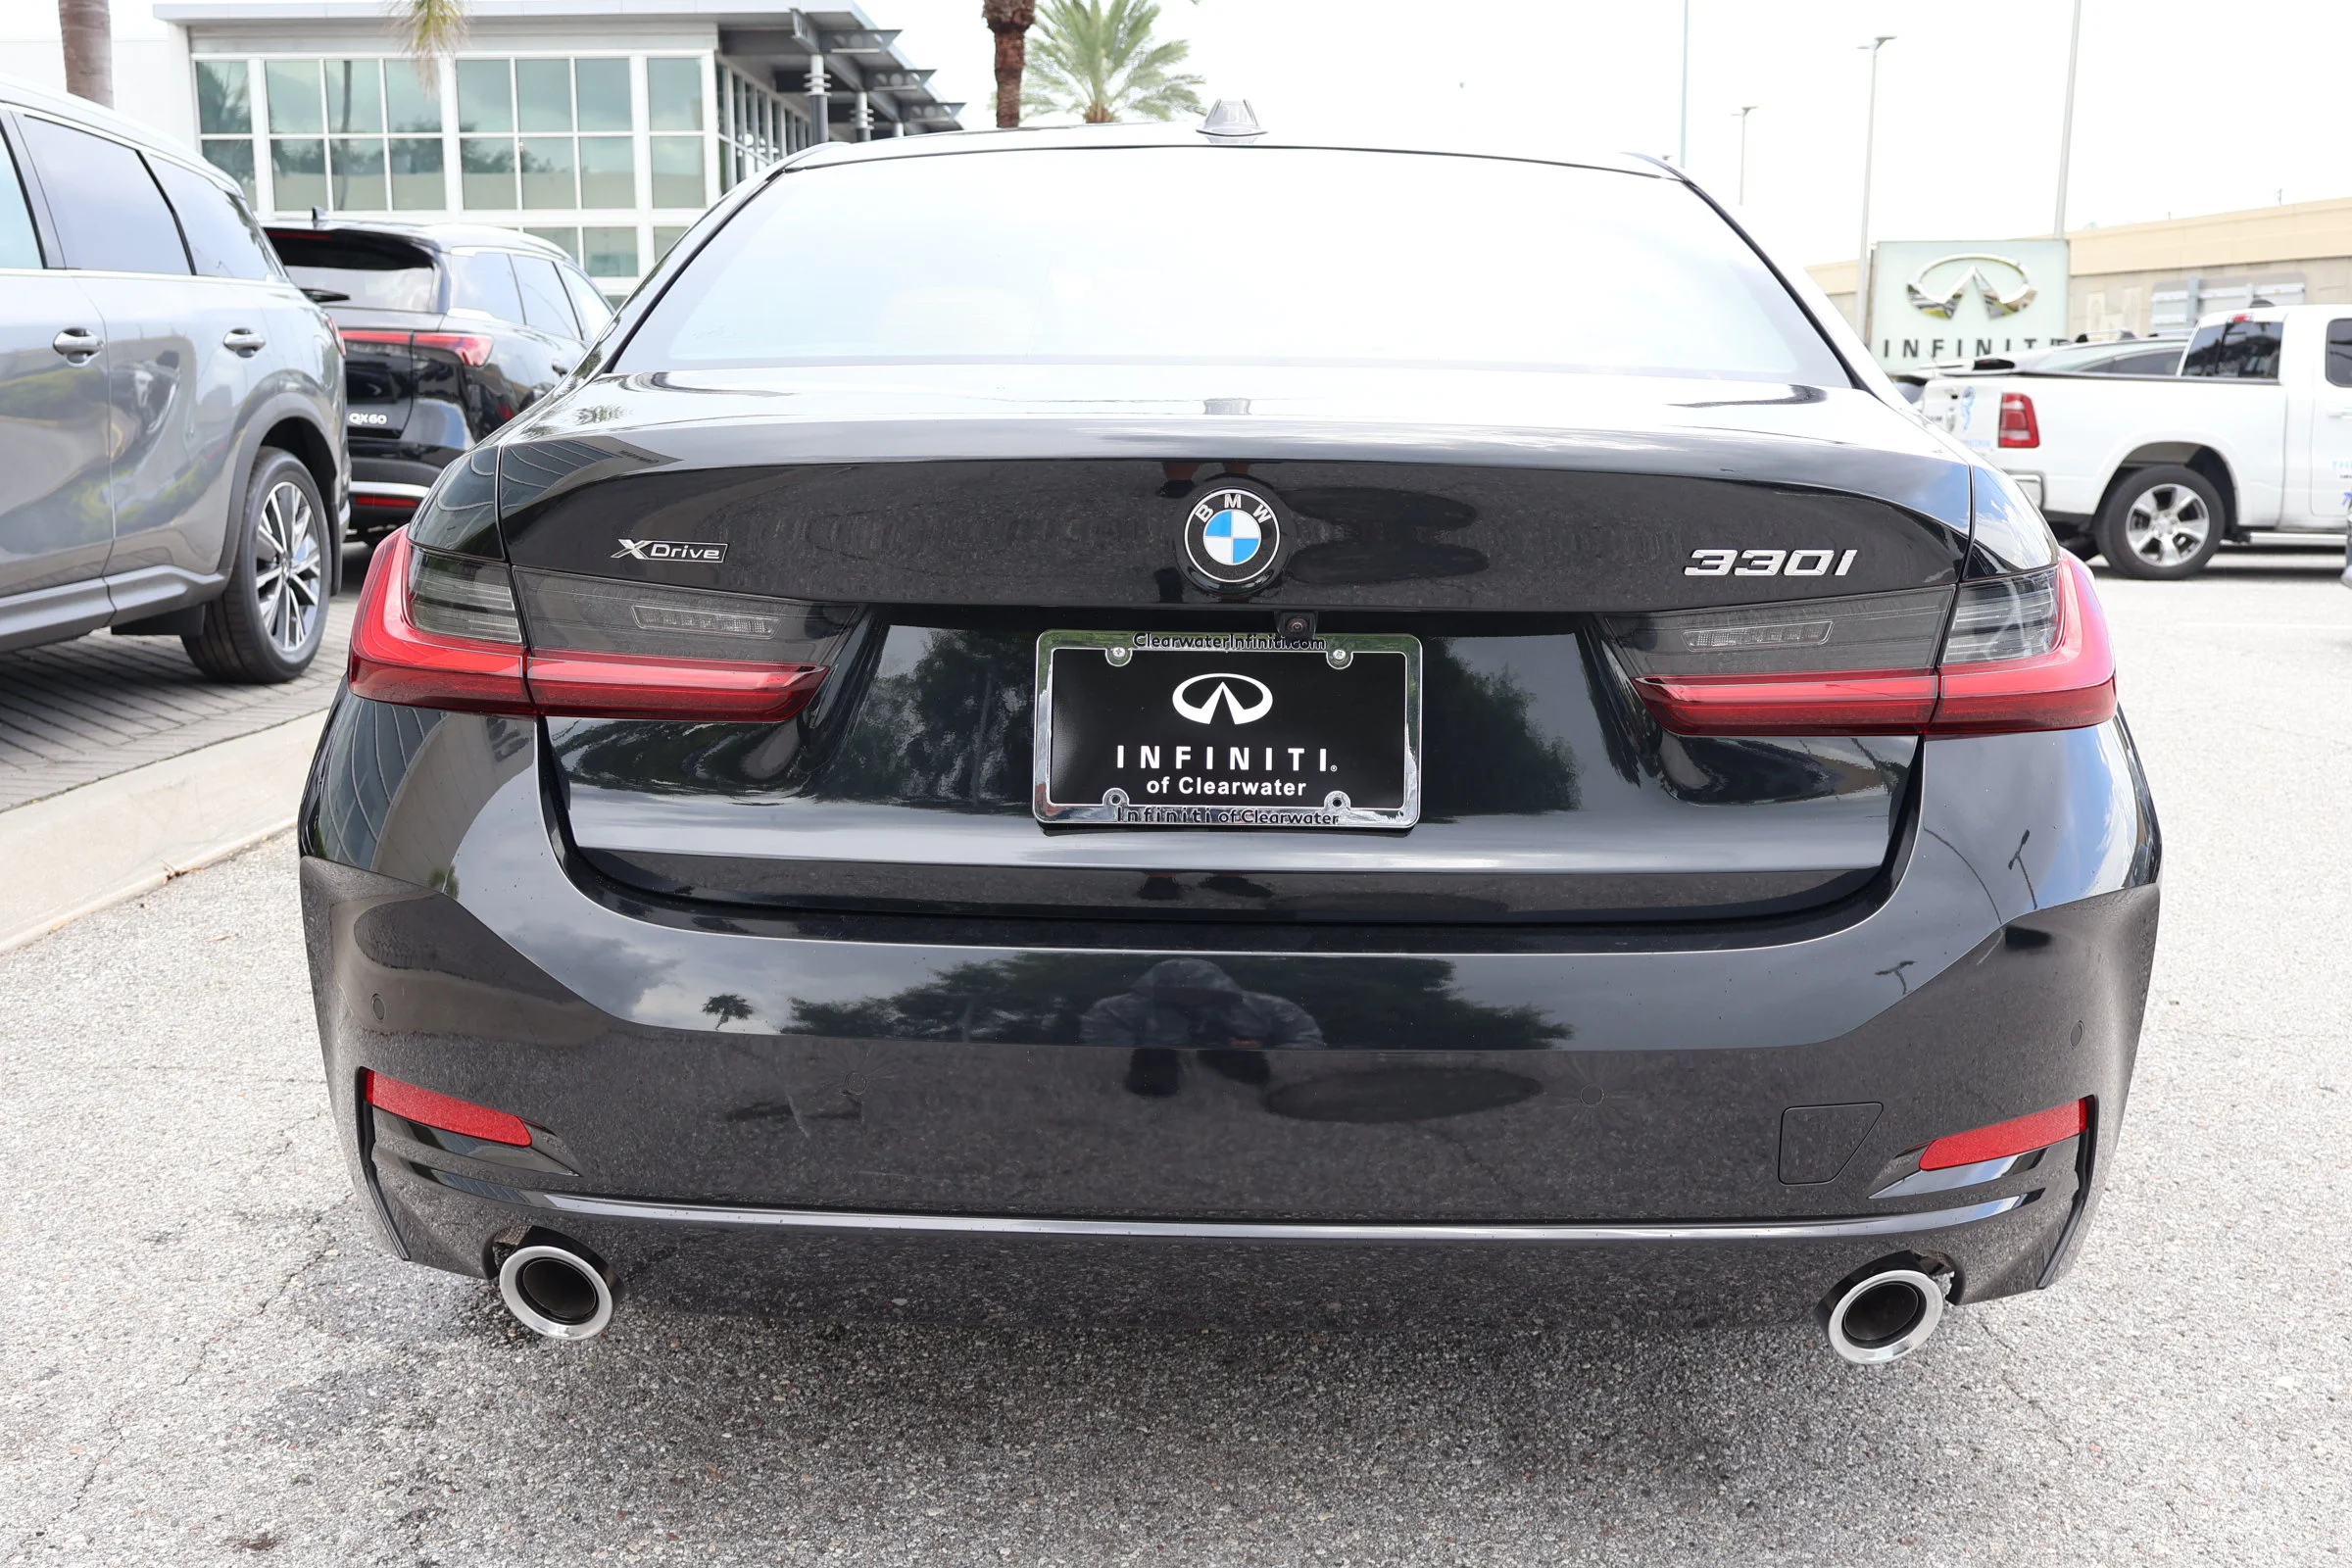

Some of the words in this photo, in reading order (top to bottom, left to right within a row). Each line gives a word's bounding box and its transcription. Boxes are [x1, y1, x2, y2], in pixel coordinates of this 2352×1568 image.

[349, 413, 388, 425] QX60
[1195, 493, 1272, 523] BMW
[1133, 632, 1327, 651] ClearwaterInfiniti.com
[1116, 745, 1327, 772] INFINITI
[1146, 776, 1170, 794] of
[1178, 777, 1307, 796] Clearwater
[1117, 807, 1212, 823] Infiniti
[1218, 808, 1239, 823] of
[1240, 809, 1339, 825] Clearwater
